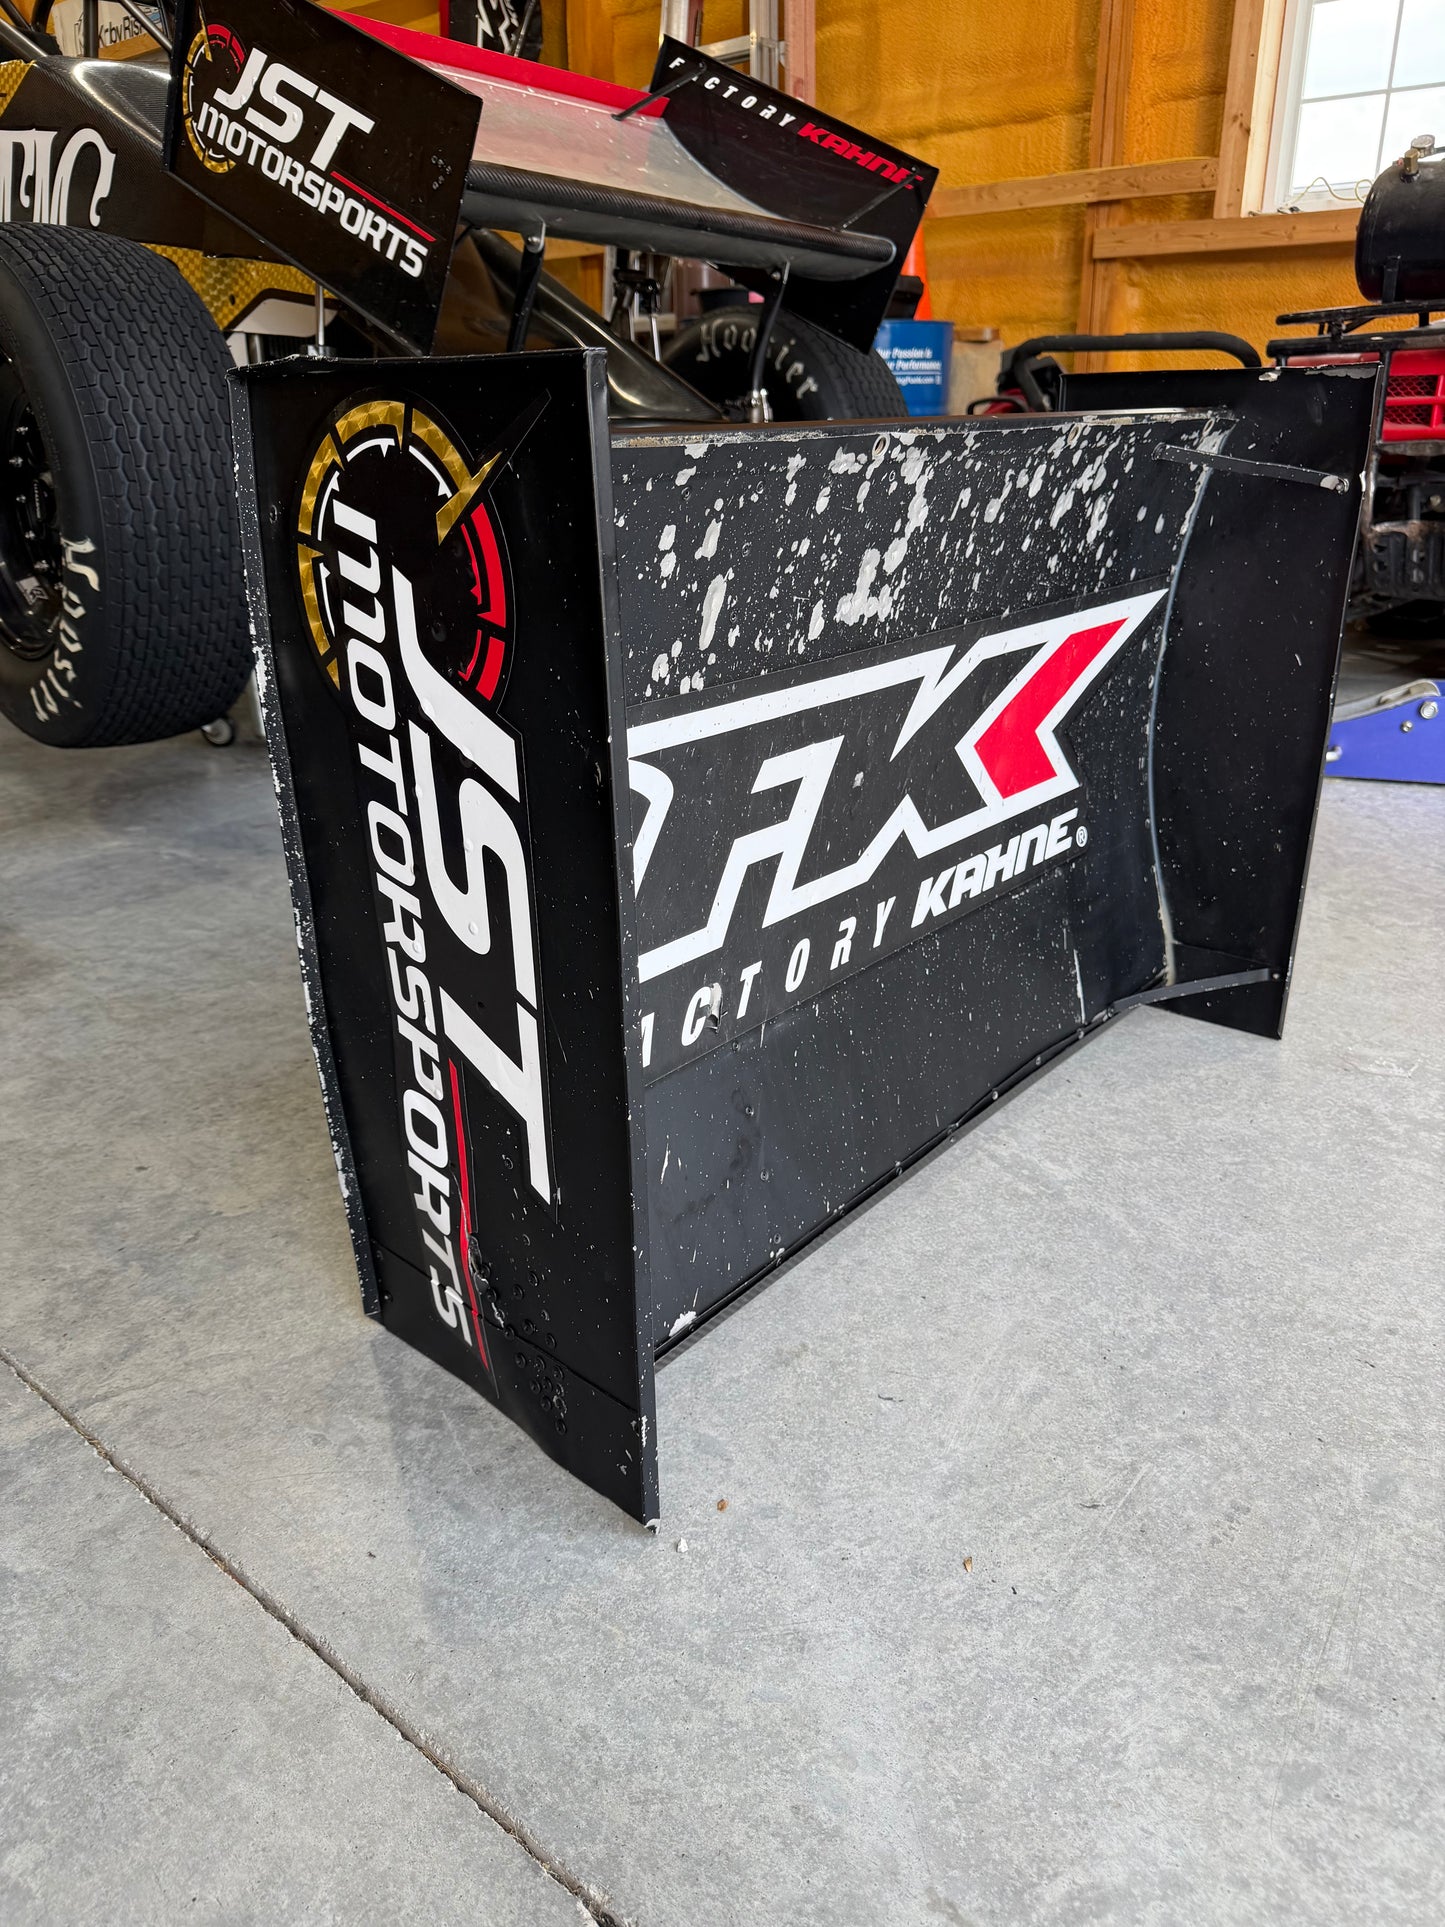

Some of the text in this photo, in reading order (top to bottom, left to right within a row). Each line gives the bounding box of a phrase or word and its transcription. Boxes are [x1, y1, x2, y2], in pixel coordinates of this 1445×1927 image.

[213, 47, 376, 172] JST
[668, 57, 796, 128] FCTORY
[197, 101, 429, 278] MOTORSPORTS
[332, 499, 474, 1348] MOTORSPORTS
[392, 564, 552, 1205] JST
[640, 896, 896, 1068] CTORY
